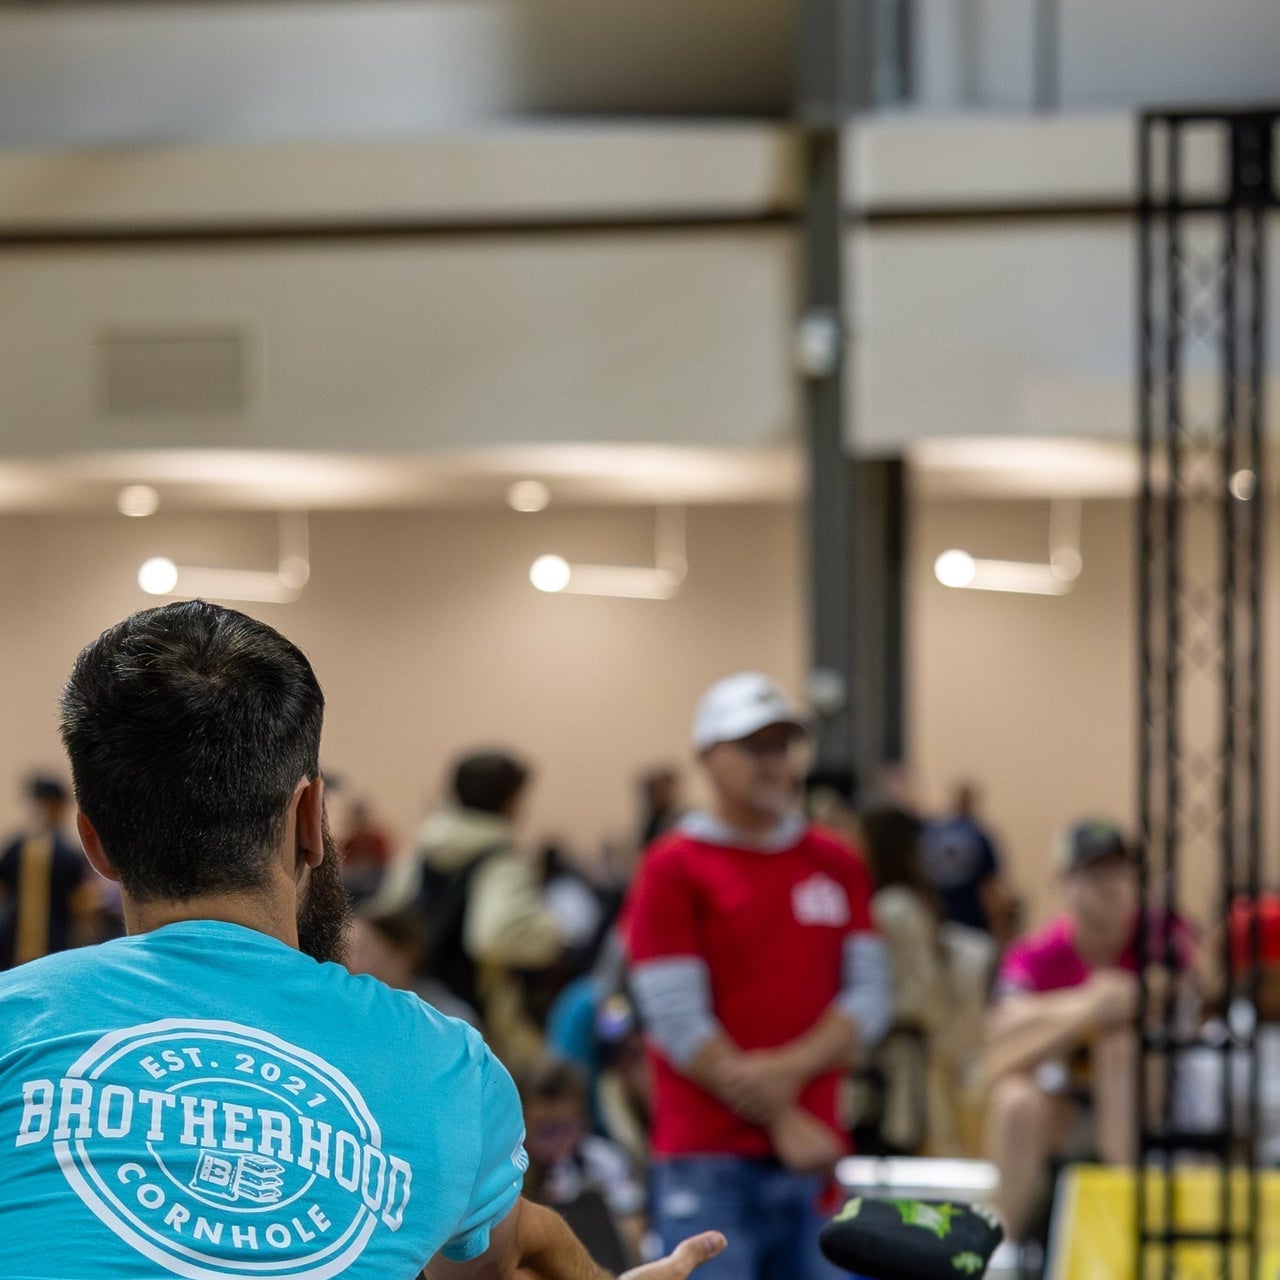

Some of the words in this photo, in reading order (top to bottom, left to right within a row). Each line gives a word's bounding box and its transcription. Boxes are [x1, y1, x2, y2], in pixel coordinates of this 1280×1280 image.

[138, 1046, 219, 1081] EST.
[234, 1053, 328, 1108] 2021
[14, 1077, 414, 1233] BROTHERHOOD
[116, 1161, 333, 1250] CORNHOLE
